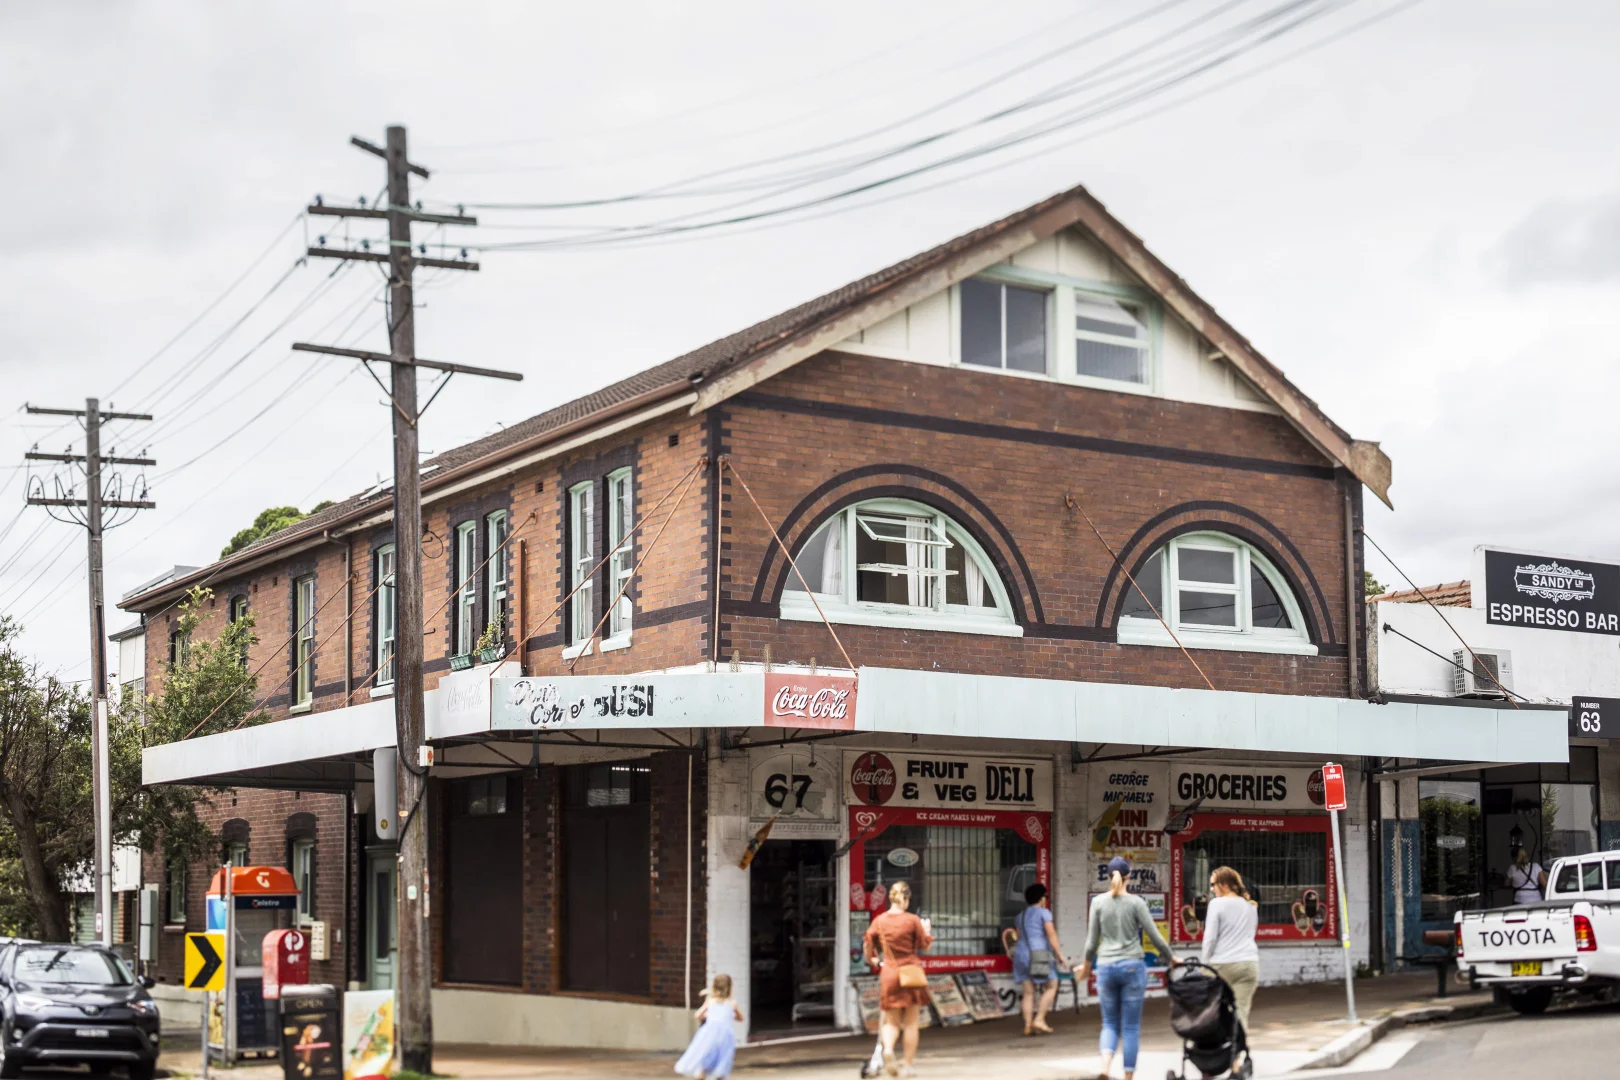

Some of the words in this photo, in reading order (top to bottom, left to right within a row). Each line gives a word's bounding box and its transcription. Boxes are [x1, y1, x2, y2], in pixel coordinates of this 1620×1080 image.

[1532, 575, 1572, 589] SANDY
[1490, 603, 1579, 627] ESPRESSO
[1586, 612, 1618, 631] BAR
[792, 685, 808, 693] Enjoy
[772, 686, 850, 719] Coca-Cola
[1580, 711, 1601, 732] 63
[852, 767, 893, 786] Coca-Cola
[907, 760, 968, 779] FRUIT
[985, 765, 1035, 802] DELI
[1109, 774, 1149, 786] GEORGE
[1178, 772, 1287, 801] GROCERIES
[764, 773, 813, 808] 67
[902, 782, 919, 800] &
[934, 784, 977, 802] VEG
[1103, 791, 1154, 803] MICHAEL'S
[1093, 829, 1165, 848] ARKET
[1478, 928, 1556, 947] TOYOTA
